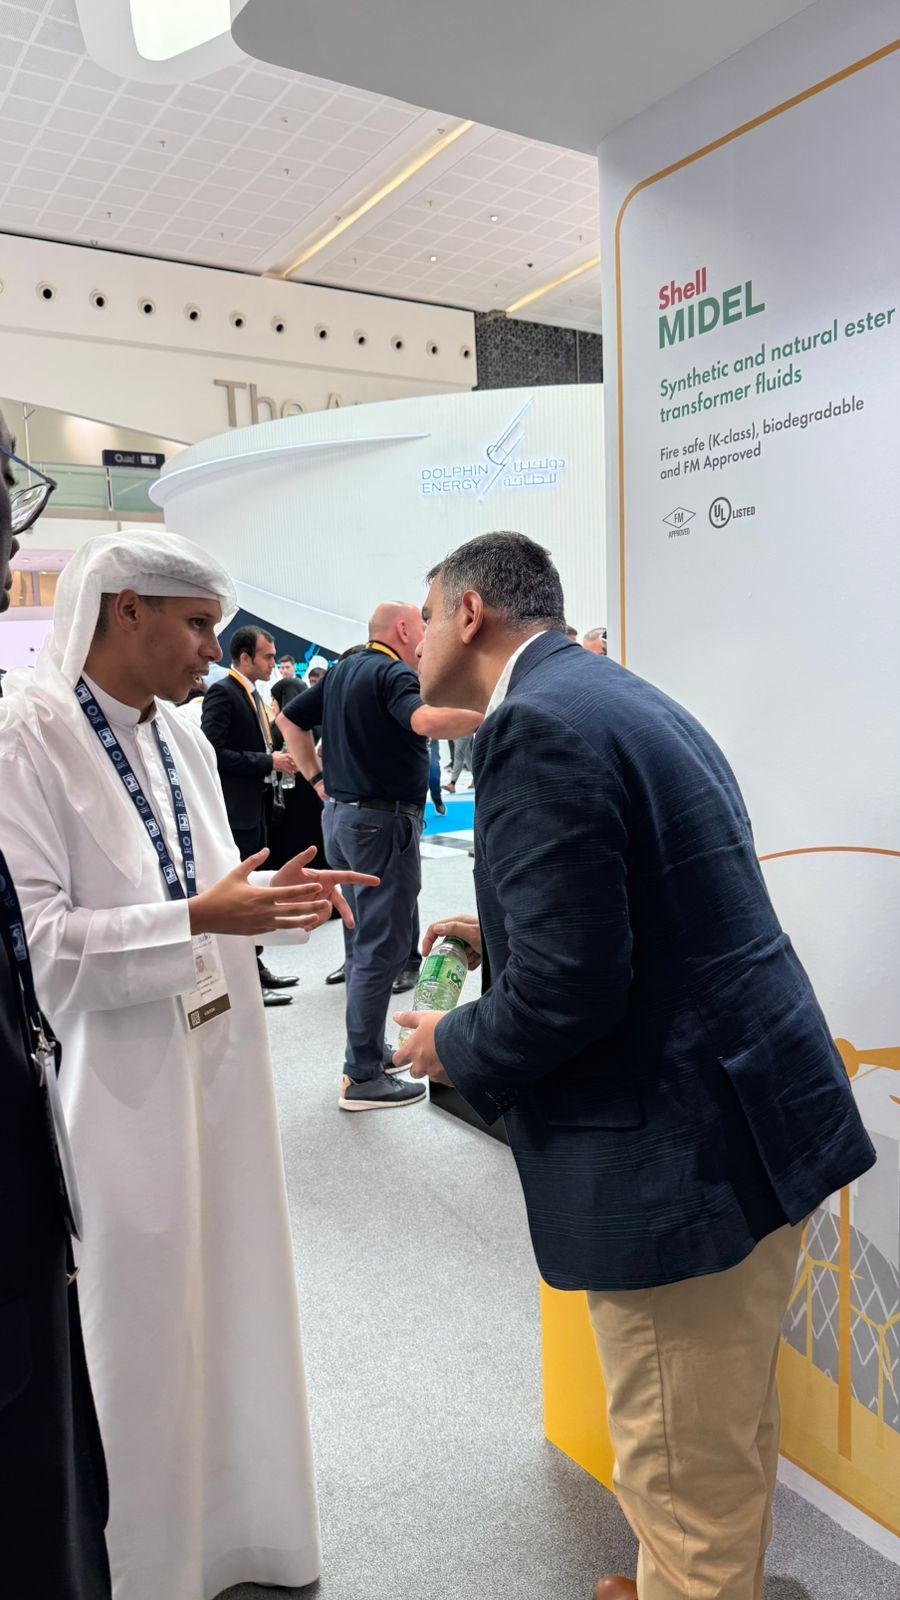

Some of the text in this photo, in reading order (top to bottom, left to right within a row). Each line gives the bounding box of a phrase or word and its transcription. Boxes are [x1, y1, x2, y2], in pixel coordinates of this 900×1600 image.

[658, 266, 708, 310] Shell
[658, 279, 766, 349] MIDEL
[660, 307, 896, 400] Synthetic and natural ester
[660, 363, 802, 423] transformer fluids
[660, 395, 865, 461] Fire safe (K-class), biodegradable
[421, 464, 489, 480] DOLPHIN
[660, 441, 762, 480] and FM Approved
[422, 479, 481, 494] ENERGY
[674, 512, 684, 524] FM
[714, 504, 756, 521] UL LISTED
[668, 527, 690, 539] APPROVED
